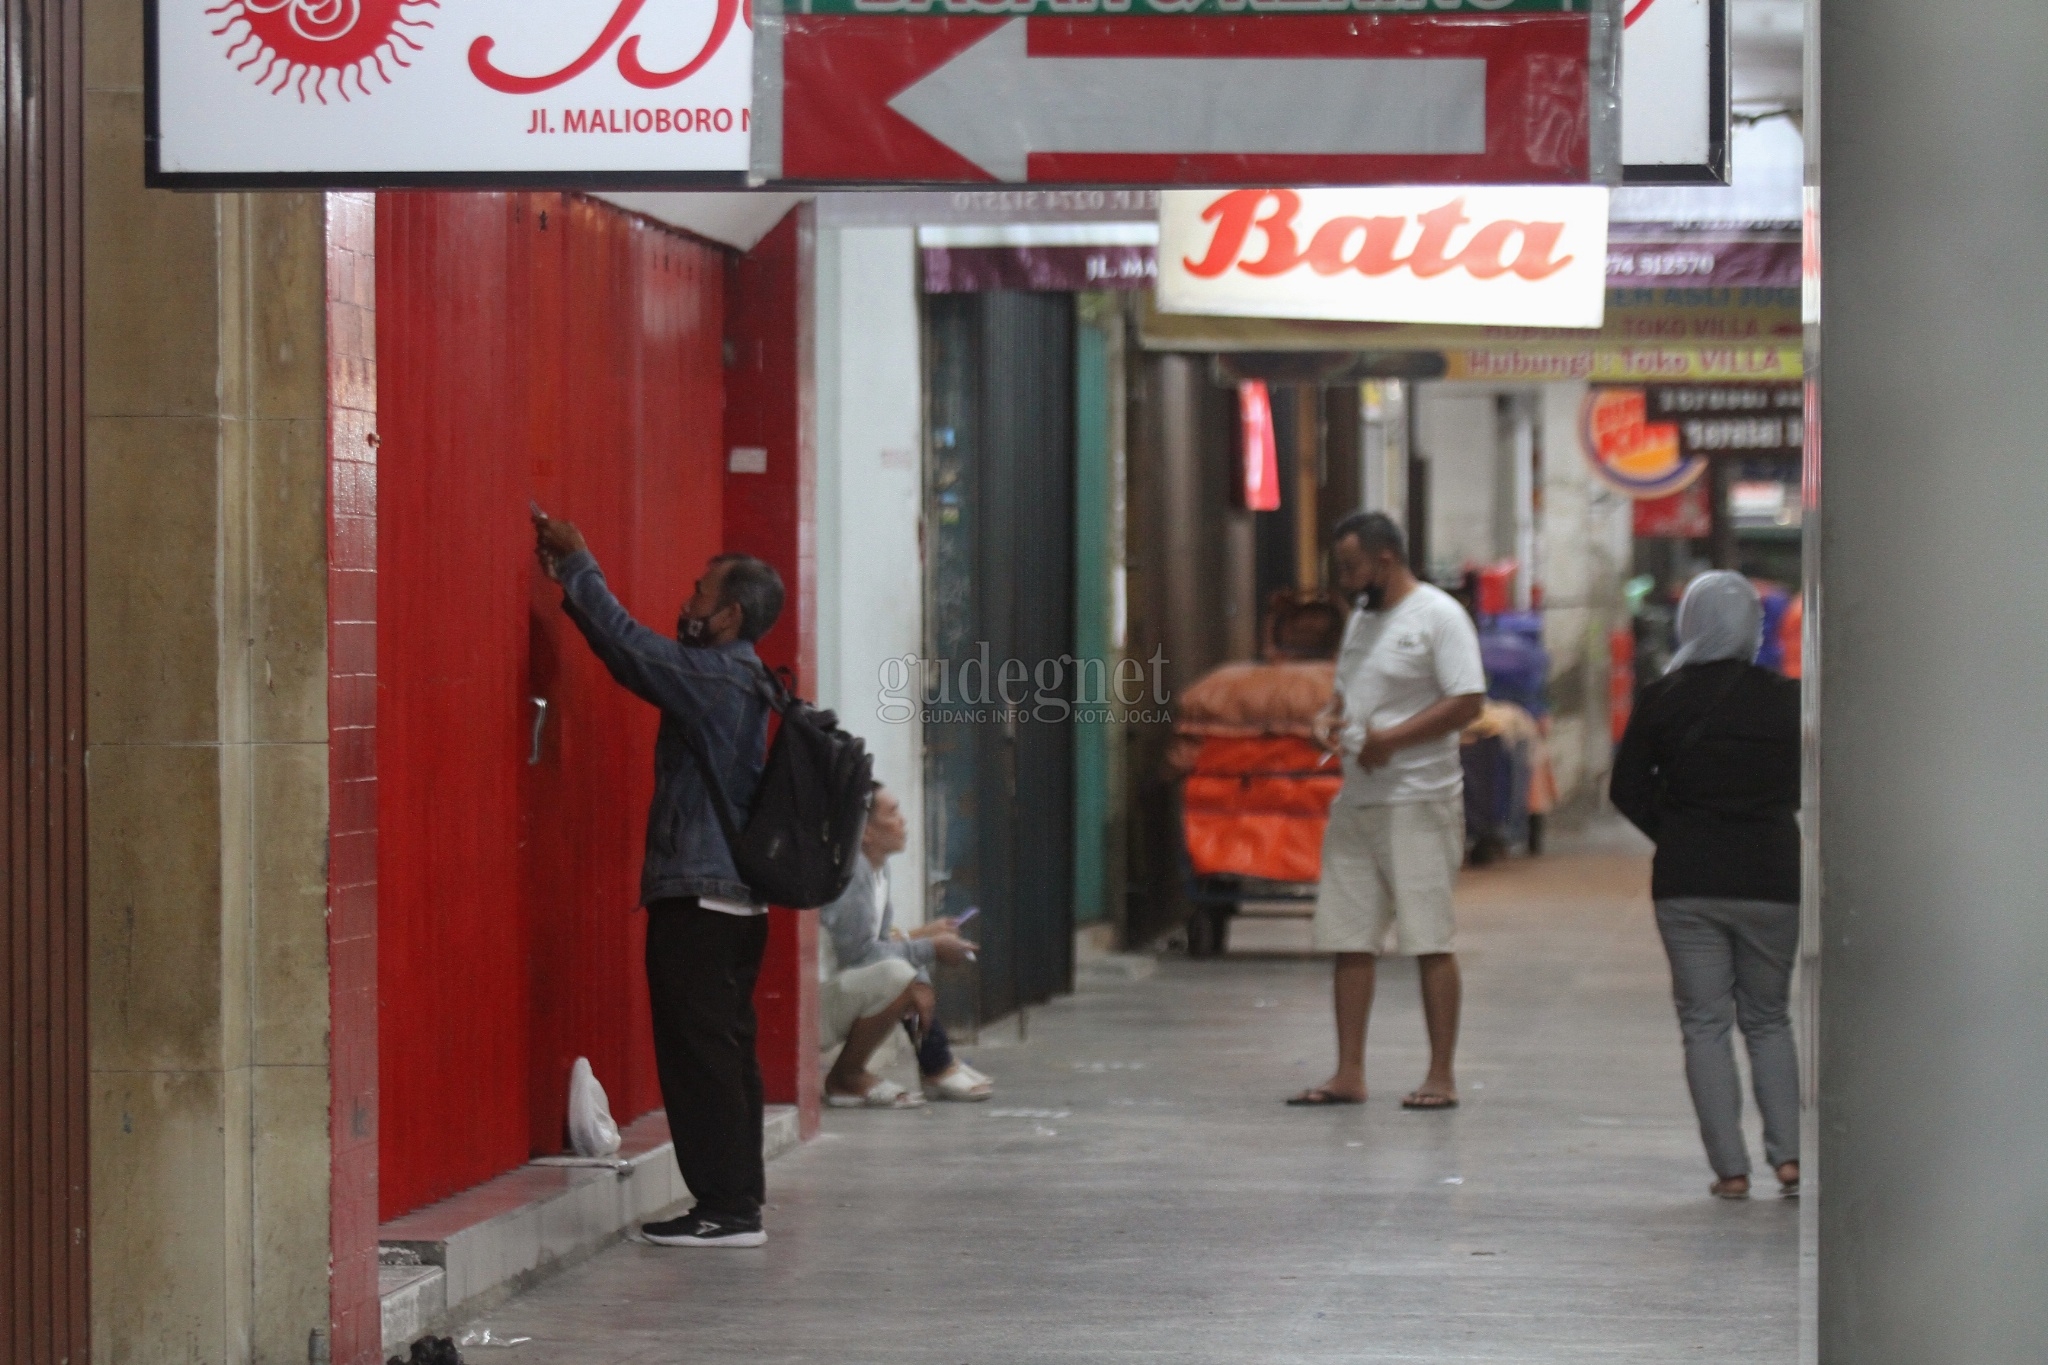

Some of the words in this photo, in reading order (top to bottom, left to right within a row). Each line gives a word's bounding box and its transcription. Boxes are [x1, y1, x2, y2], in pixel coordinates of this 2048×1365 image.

[563, 108, 734, 134] MALIOBORO
[1183, 188, 1575, 282] Bata
[1621, 318, 1686, 339] TOKO
[1693, 318, 1760, 339] VILLA
[1469, 350, 1595, 378] Hubungi
[1621, 349, 1687, 374] Toko
[1698, 348, 1781, 372] VILLA
